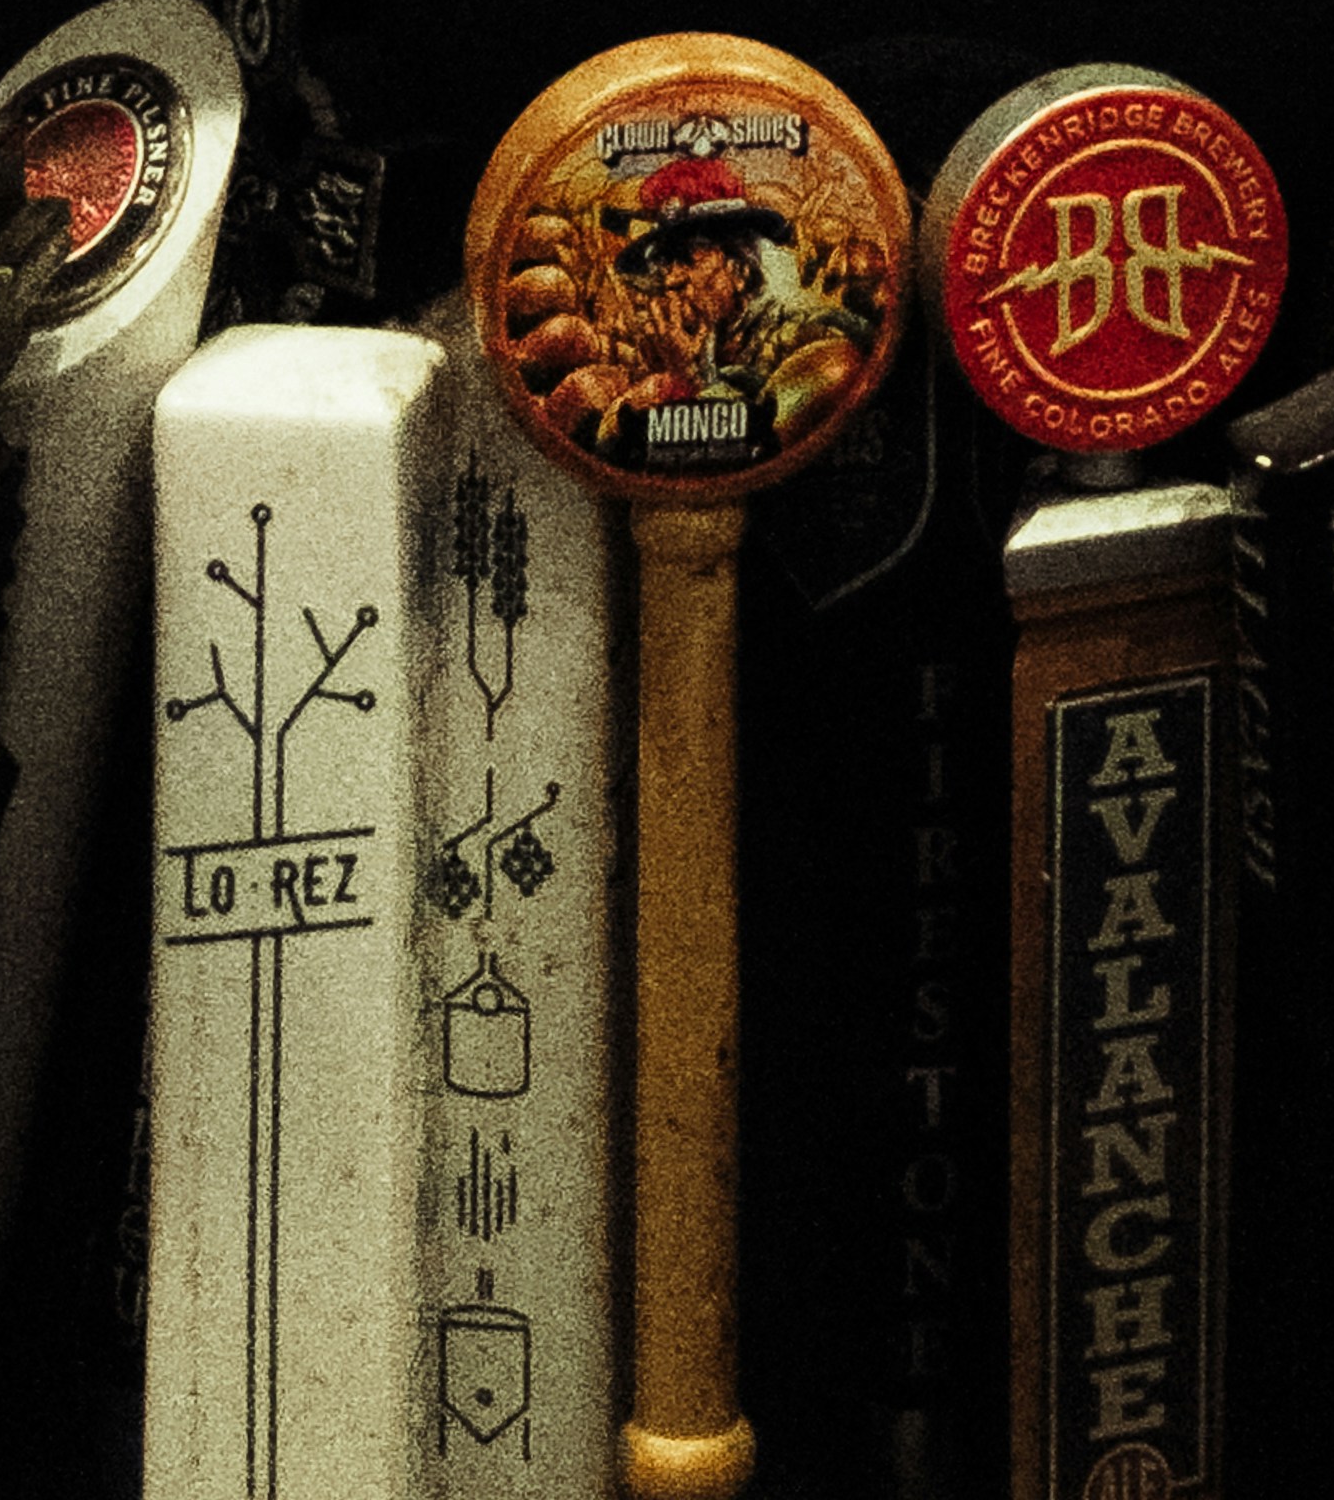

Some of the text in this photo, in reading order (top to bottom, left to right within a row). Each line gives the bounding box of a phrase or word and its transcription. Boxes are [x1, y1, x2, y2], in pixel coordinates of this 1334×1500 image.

[122, 77, 172, 210] PILSNER
[596, 113, 804, 162] CLOWN SHOES
[966, 100, 1270, 276] BRECKENRIDGE BREWERY
[646, 402, 749, 443] MANGO
[969, 288, 1270, 440] FINE COLORADO ALES
[271, 853, 359, 926] REZ
[902, 660, 959, 1381] FIRESTONE
[1081, 708, 1179, 1443] AVALANCHE
